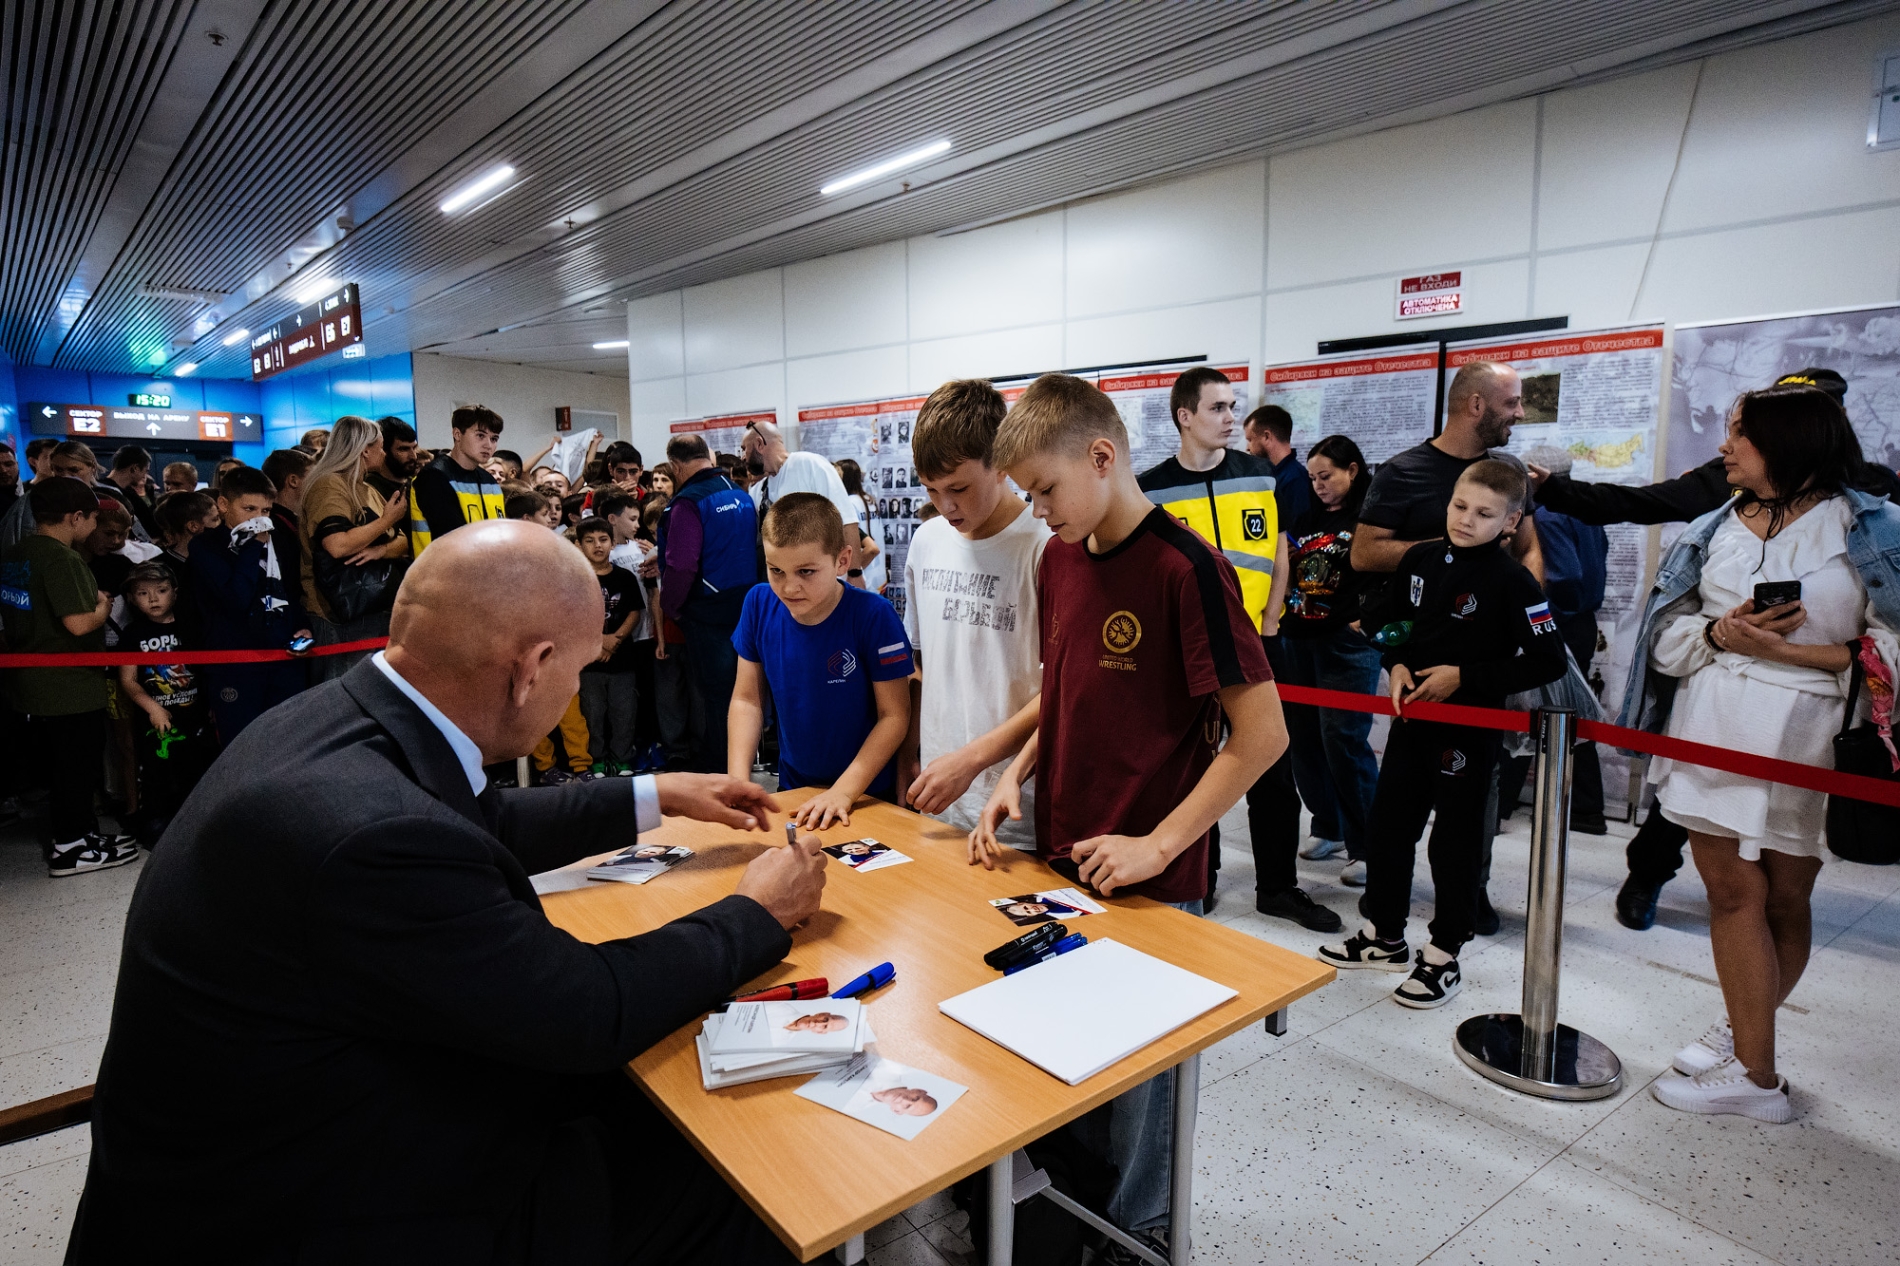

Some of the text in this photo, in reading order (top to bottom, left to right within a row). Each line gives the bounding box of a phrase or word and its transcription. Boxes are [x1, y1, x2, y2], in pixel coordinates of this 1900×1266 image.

[1404, 279, 1457, 293] НЕ ВХОДИ
[1419, 274, 1441, 284] ГАЗ
[1402, 294, 1458, 308] АВТОМАТИКА
[1404, 302, 1456, 315] ОТКЛЮЧЕНА
[1453, 336, 1655, 365] Сибиряки на защите Отечества
[1270, 357, 1433, 383] Сибиряки на защите Отечества
[136, 393, 171, 407] 15:20
[69, 409, 103, 418] СЕКТОР
[113, 411, 190, 423] ВЫХОД НА АРЕНУ
[199, 416, 230, 424] СЕКТОР
[73, 417, 101, 433] E2
[1250, 518, 1262, 533] 22
[140, 634, 181, 653] БОРЬ
[1098, 659, 1137, 672] WRESTLING
